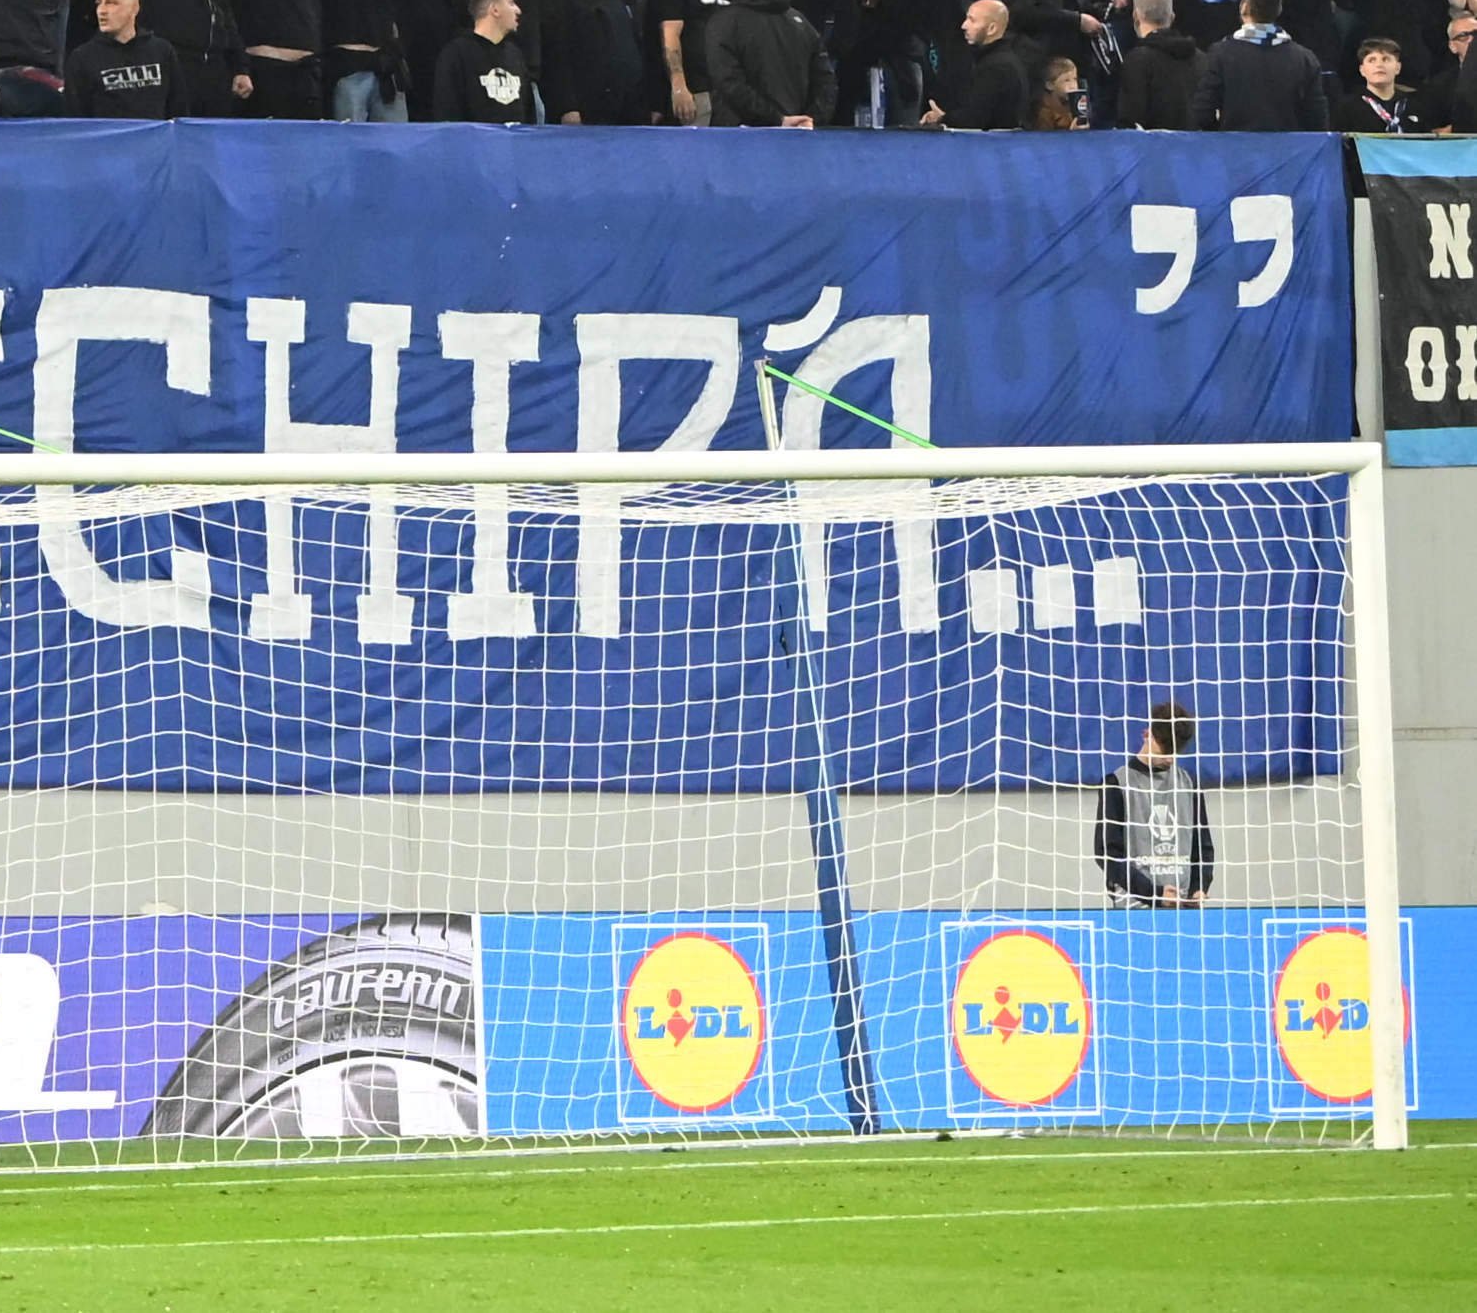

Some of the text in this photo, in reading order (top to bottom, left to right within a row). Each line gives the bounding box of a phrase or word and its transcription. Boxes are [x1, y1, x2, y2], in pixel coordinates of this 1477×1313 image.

[272, 962, 465, 1030] Laufenn
[633, 987, 753, 1048] LIDL
[961, 985, 1080, 1047] LIDL
[1283, 982, 1371, 1040] LID
